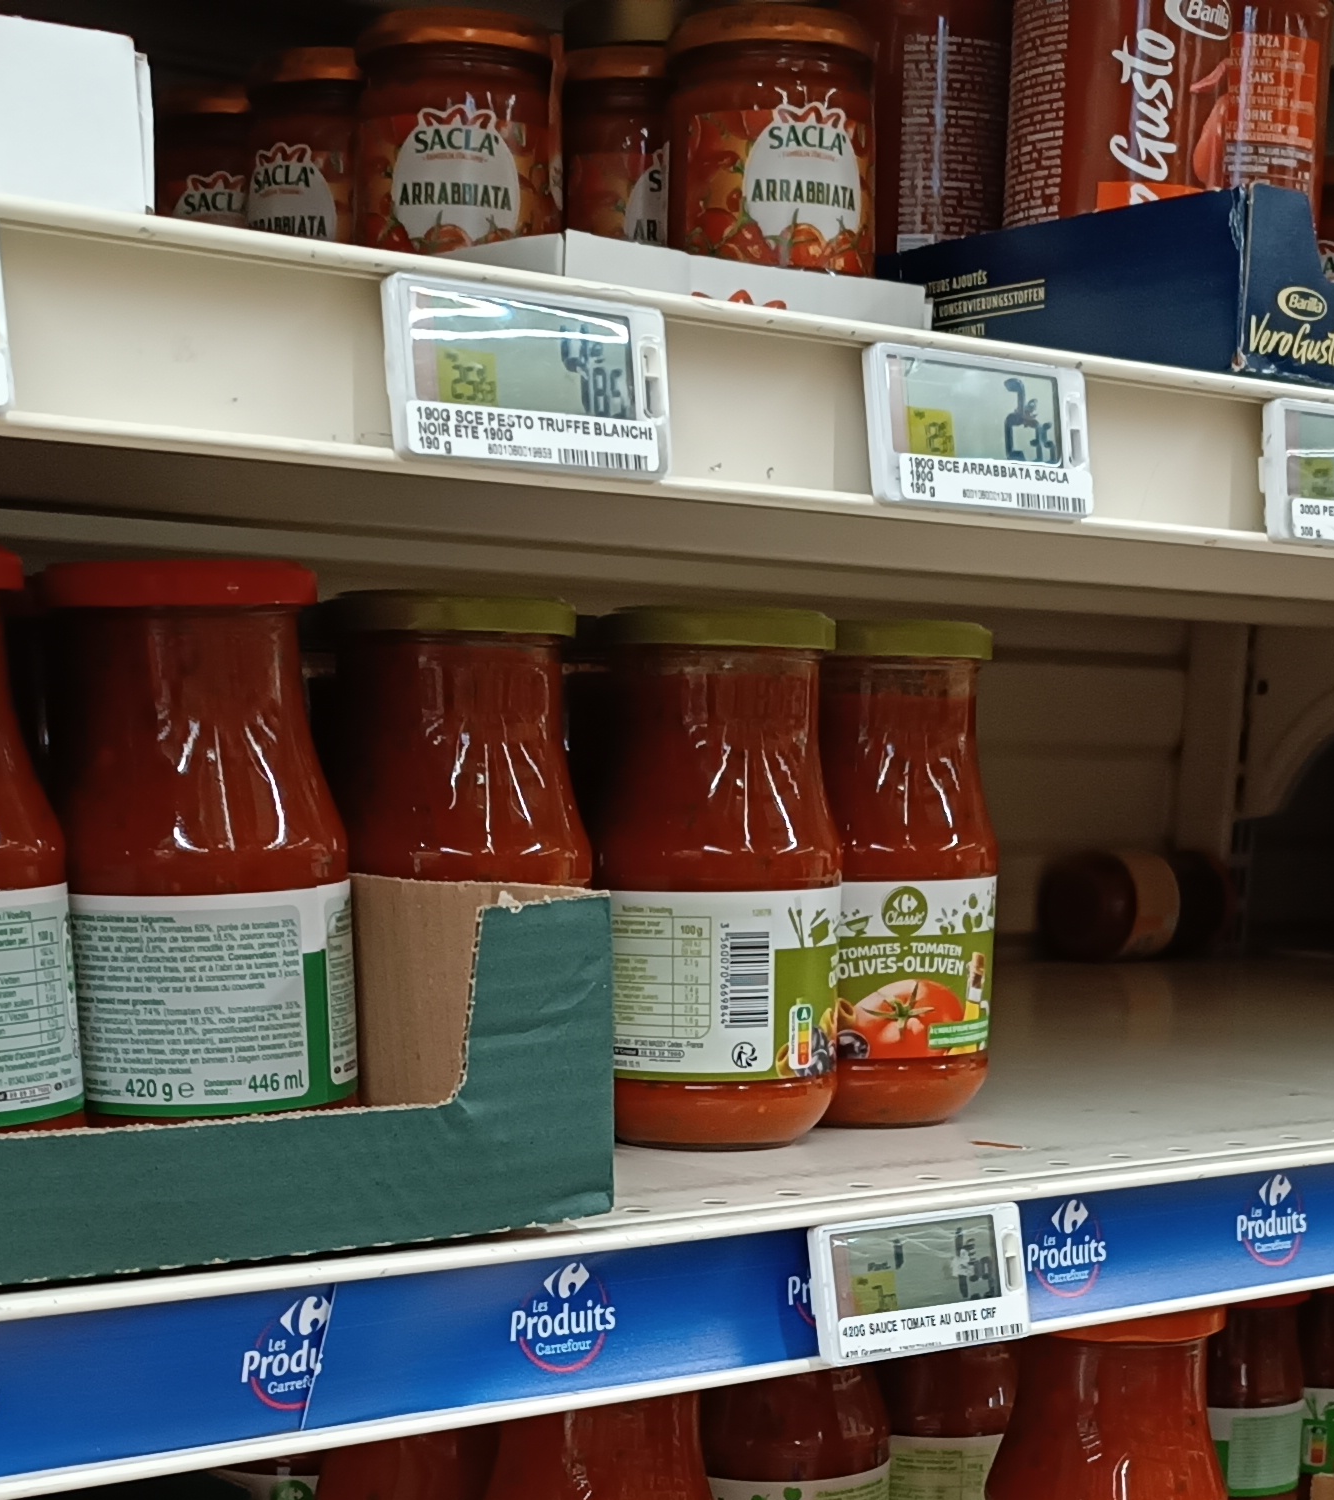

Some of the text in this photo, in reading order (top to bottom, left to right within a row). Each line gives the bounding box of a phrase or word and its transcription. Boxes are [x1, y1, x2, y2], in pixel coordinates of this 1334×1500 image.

[398, 181, 513, 212] ARRABBIATA
[751, 179, 856, 212] ARRABBIATA
[1287, 292, 1325, 314] Barilla
[416, 406, 451, 422] 190G
[455, 409, 484, 426] SCE
[488, 412, 534, 430] PESTO
[538, 417, 590, 436] TRUFFE
[417, 421, 514, 442] NOIR ETE 190G
[418, 436, 440, 451] 190
[908, 457, 1069, 484] 190G SCE ARRABBIATA SACLA
[910, 482, 926, 495] 190
[1299, 503, 1321, 516] 300G
[842, 942, 963, 962] TOMATES TOMATEN
[836, 956, 965, 980] OLIVES-OLIJVEN
[125, 1078, 173, 1102] 420 g
[248, 1069, 305, 1094] 446 ml
[1236, 1208, 1307, 1243] Produits
[1043, 1234, 1056, 1247] Les
[1028, 1236, 1107, 1273] Produits
[531, 1299, 549, 1314] Les
[510, 1302, 616, 1344] Produits
[842, 1306, 998, 1338] 420G SAUCE TOMATE AU OLIVE CRF
[267, 1337, 286, 1353] Les
[534, 1335, 592, 1358] Carrefour
